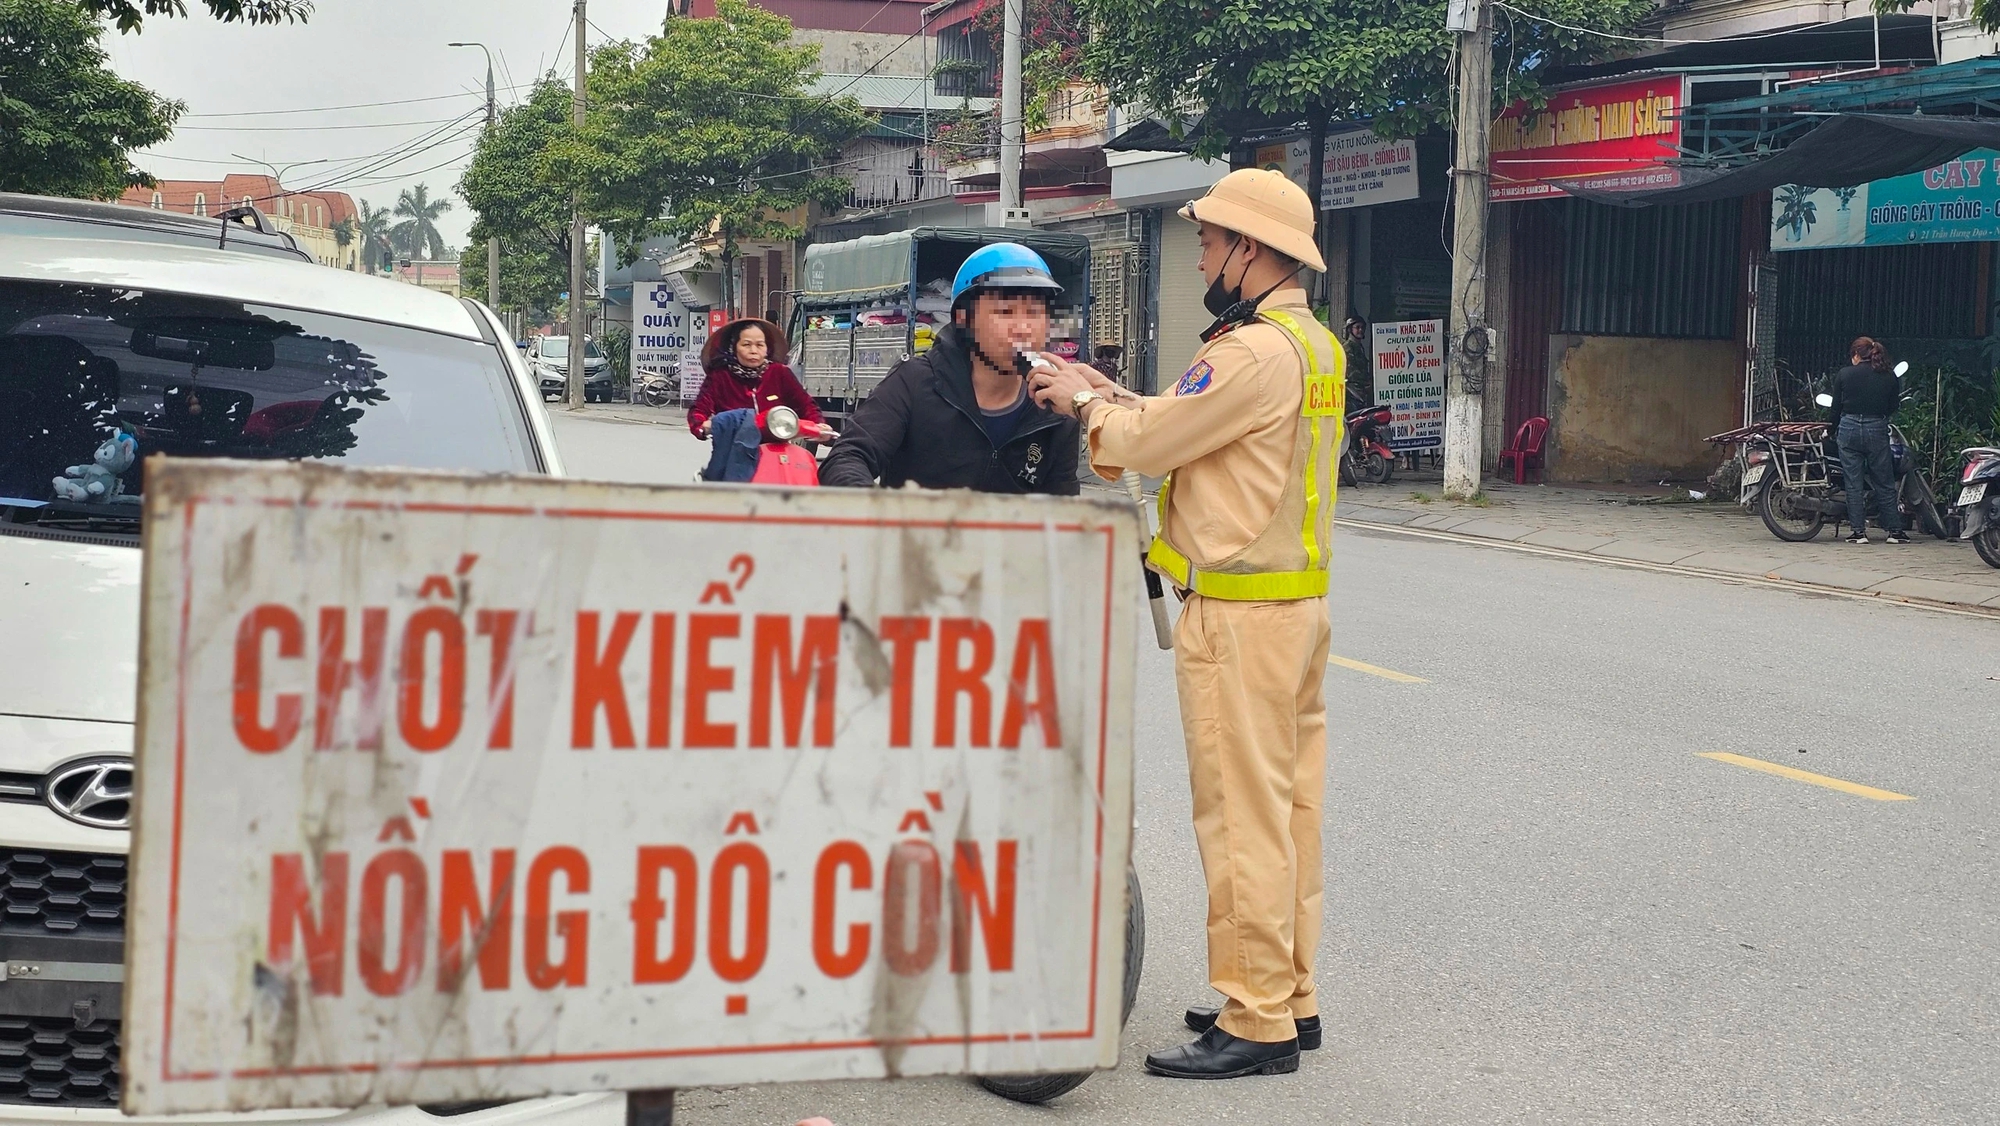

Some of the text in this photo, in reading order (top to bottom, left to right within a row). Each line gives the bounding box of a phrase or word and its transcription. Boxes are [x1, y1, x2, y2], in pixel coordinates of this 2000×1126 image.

[1601, 101, 1634, 141] NAM
[1635, 90, 1674, 136] SÁCH
[1331, 138, 1344, 152] VẬT
[1356, 133, 1379, 146] NÔNG
[1324, 155, 1336, 173] TRỪ
[1337, 154, 1350, 171] SÂU
[1351, 151, 1370, 171] BỆNH
[1374, 145, 1396, 166] GIỐNG
[1397, 144, 1411, 162] LÚA
[1923, 156, 1986, 190] CÂY
[1870, 200, 1908, 225] GIỐNG
[1911, 200, 1936, 222] CÂY
[1939, 195, 1982, 220] TRỒNG
[638, 331, 685, 348] THUỐC
[1387, 335, 1431, 345] CHUYÊN BÁN
[656, 353, 678, 361] THUỐC
[1378, 345, 1405, 369] THUỐC
[1416, 345, 1434, 355] SÂU
[1417, 358, 1440, 369] BỆNH
[1388, 370, 1432, 385] GIỐNG LÚA
[1379, 385, 1442, 402] HẠT GIỐNG RAU
[232, 554, 1061, 754] CHỐT KIỂM TRA
[267, 791, 1018, 1015] NỒNG ĐỘ CỒN
